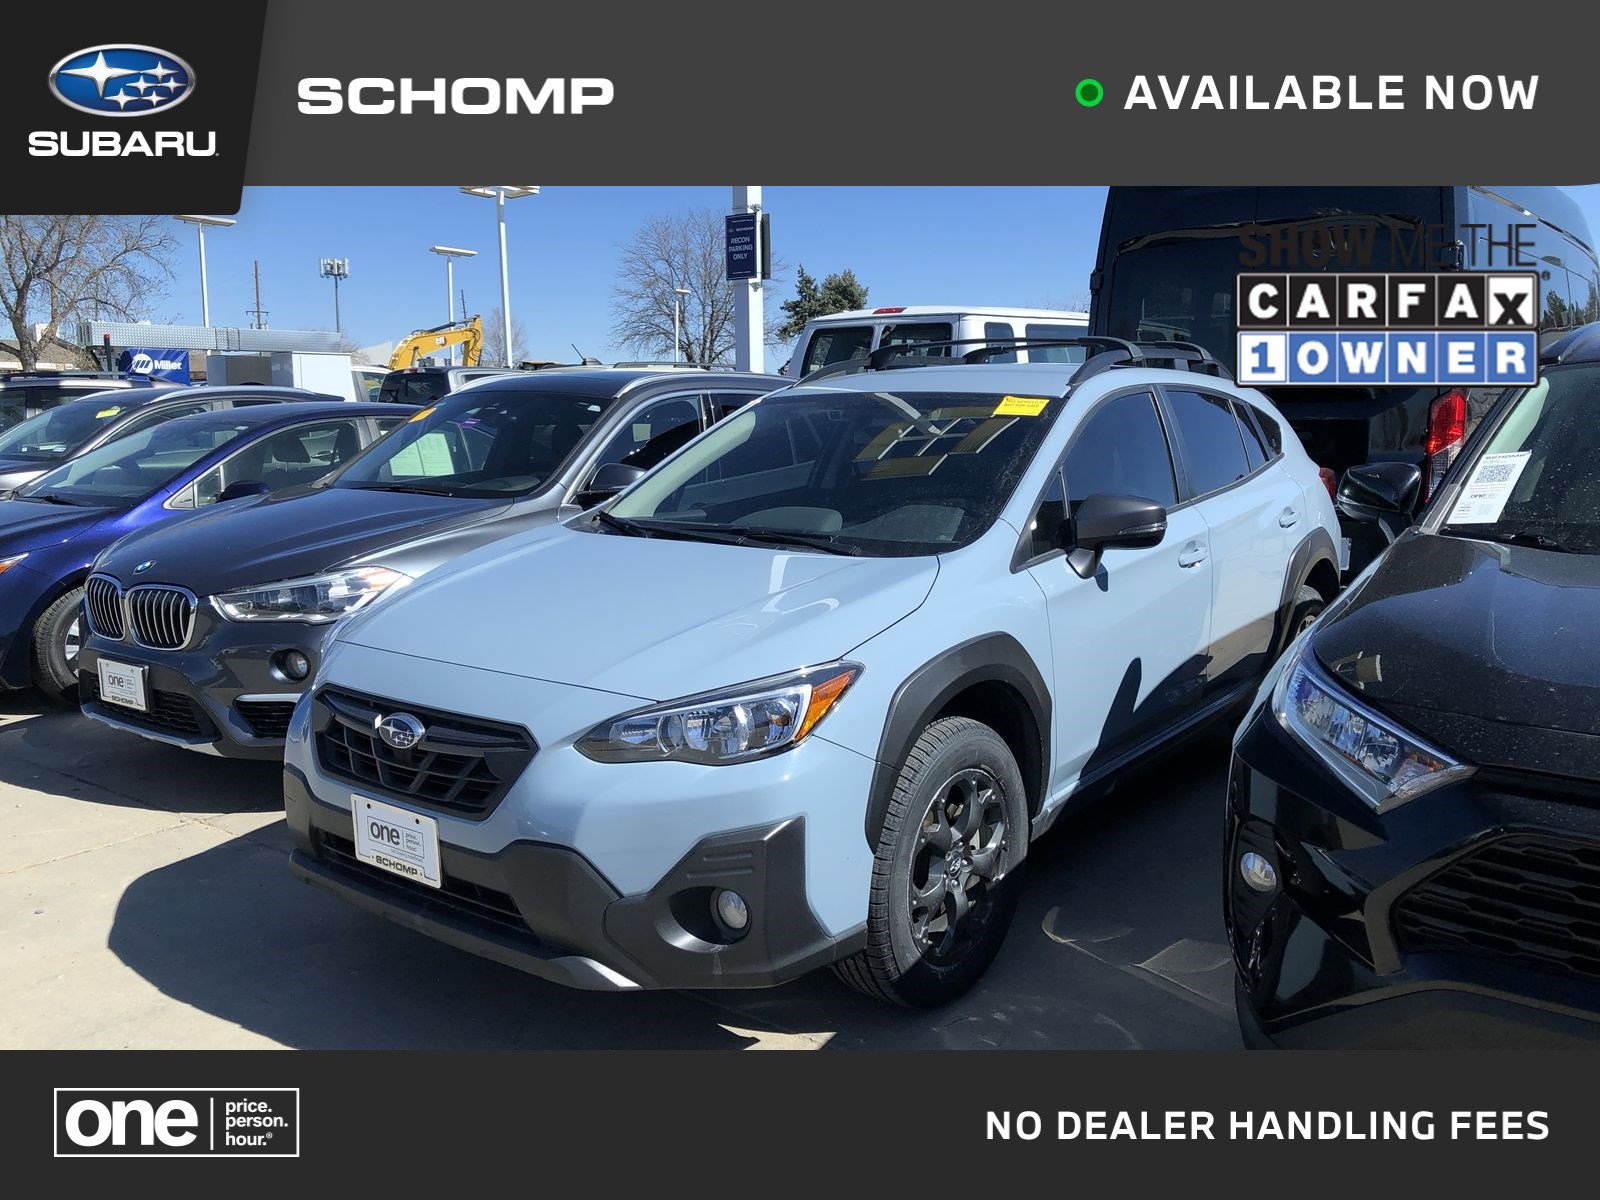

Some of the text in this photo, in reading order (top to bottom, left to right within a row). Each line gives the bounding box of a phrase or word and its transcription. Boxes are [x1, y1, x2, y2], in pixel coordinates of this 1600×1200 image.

[729, 244, 753, 252] PARKING
[109, 675, 124, 687] one
[370, 822, 400, 846] one
[376, 855, 418, 875] SCHOMP
